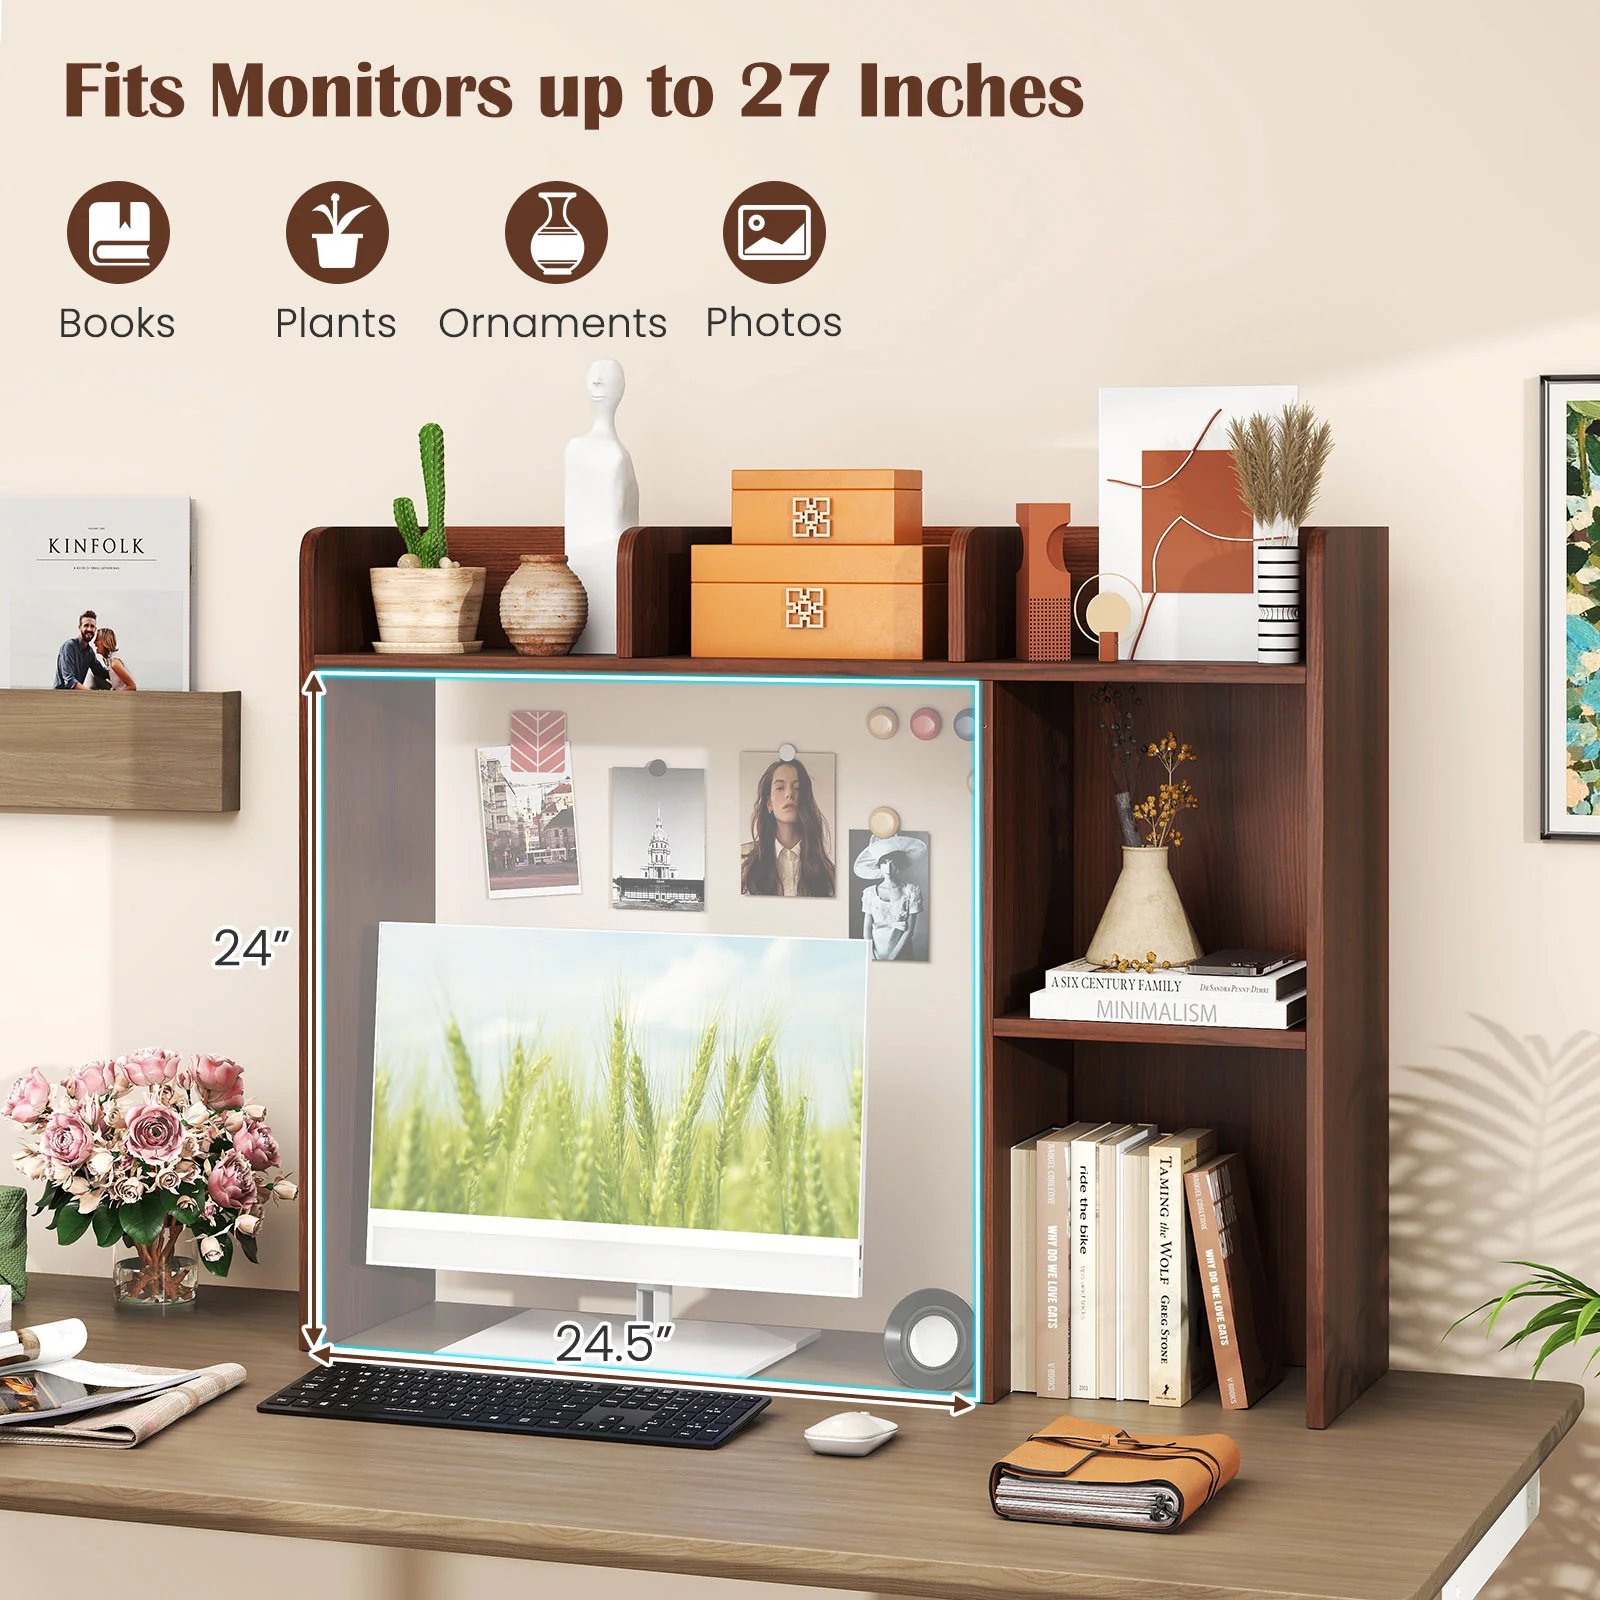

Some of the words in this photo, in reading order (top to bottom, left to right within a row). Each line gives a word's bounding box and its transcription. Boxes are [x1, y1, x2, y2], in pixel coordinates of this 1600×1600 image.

[48, 537, 145, 554] KINFOLK
[1051, 976, 1059, 988] A
[1061, 976, 1079, 989] SIX
[1081, 977, 1137, 991] CENTURY
[1138, 979, 1182, 993] FAMILY
[1097, 999, 1218, 1024] MINIMALISM
[1079, 1165, 1089, 1193] ride
[1159, 1155, 1173, 1217] TAMING
[1079, 1197, 1089, 1221] the
[1047, 1225, 1058, 1247] WHY
[1079, 1225, 1089, 1255] bike
[1159, 1221, 1170, 1238] the
[1047, 1249, 1058, 1262] DO
[1159, 1241, 1173, 1285] WOLF
[1204, 1248, 1218, 1269] WHY
[1047, 1264, 1058, 1279] WE
[1208, 1270, 1219, 1284] DO
[1047, 1280, 1058, 1304] LOVE
[1210, 1284, 1221, 1299] WE
[1047, 1305, 1058, 1329] CATS
[1160, 1294, 1171, 1327] GREG
[1213, 1300, 1225, 1323] LOVE
[1160, 1328, 1171, 1364] STONE
[1217, 1324, 1229, 1346] CATS
[1227, 1383, 1238, 1404] BOOKS
